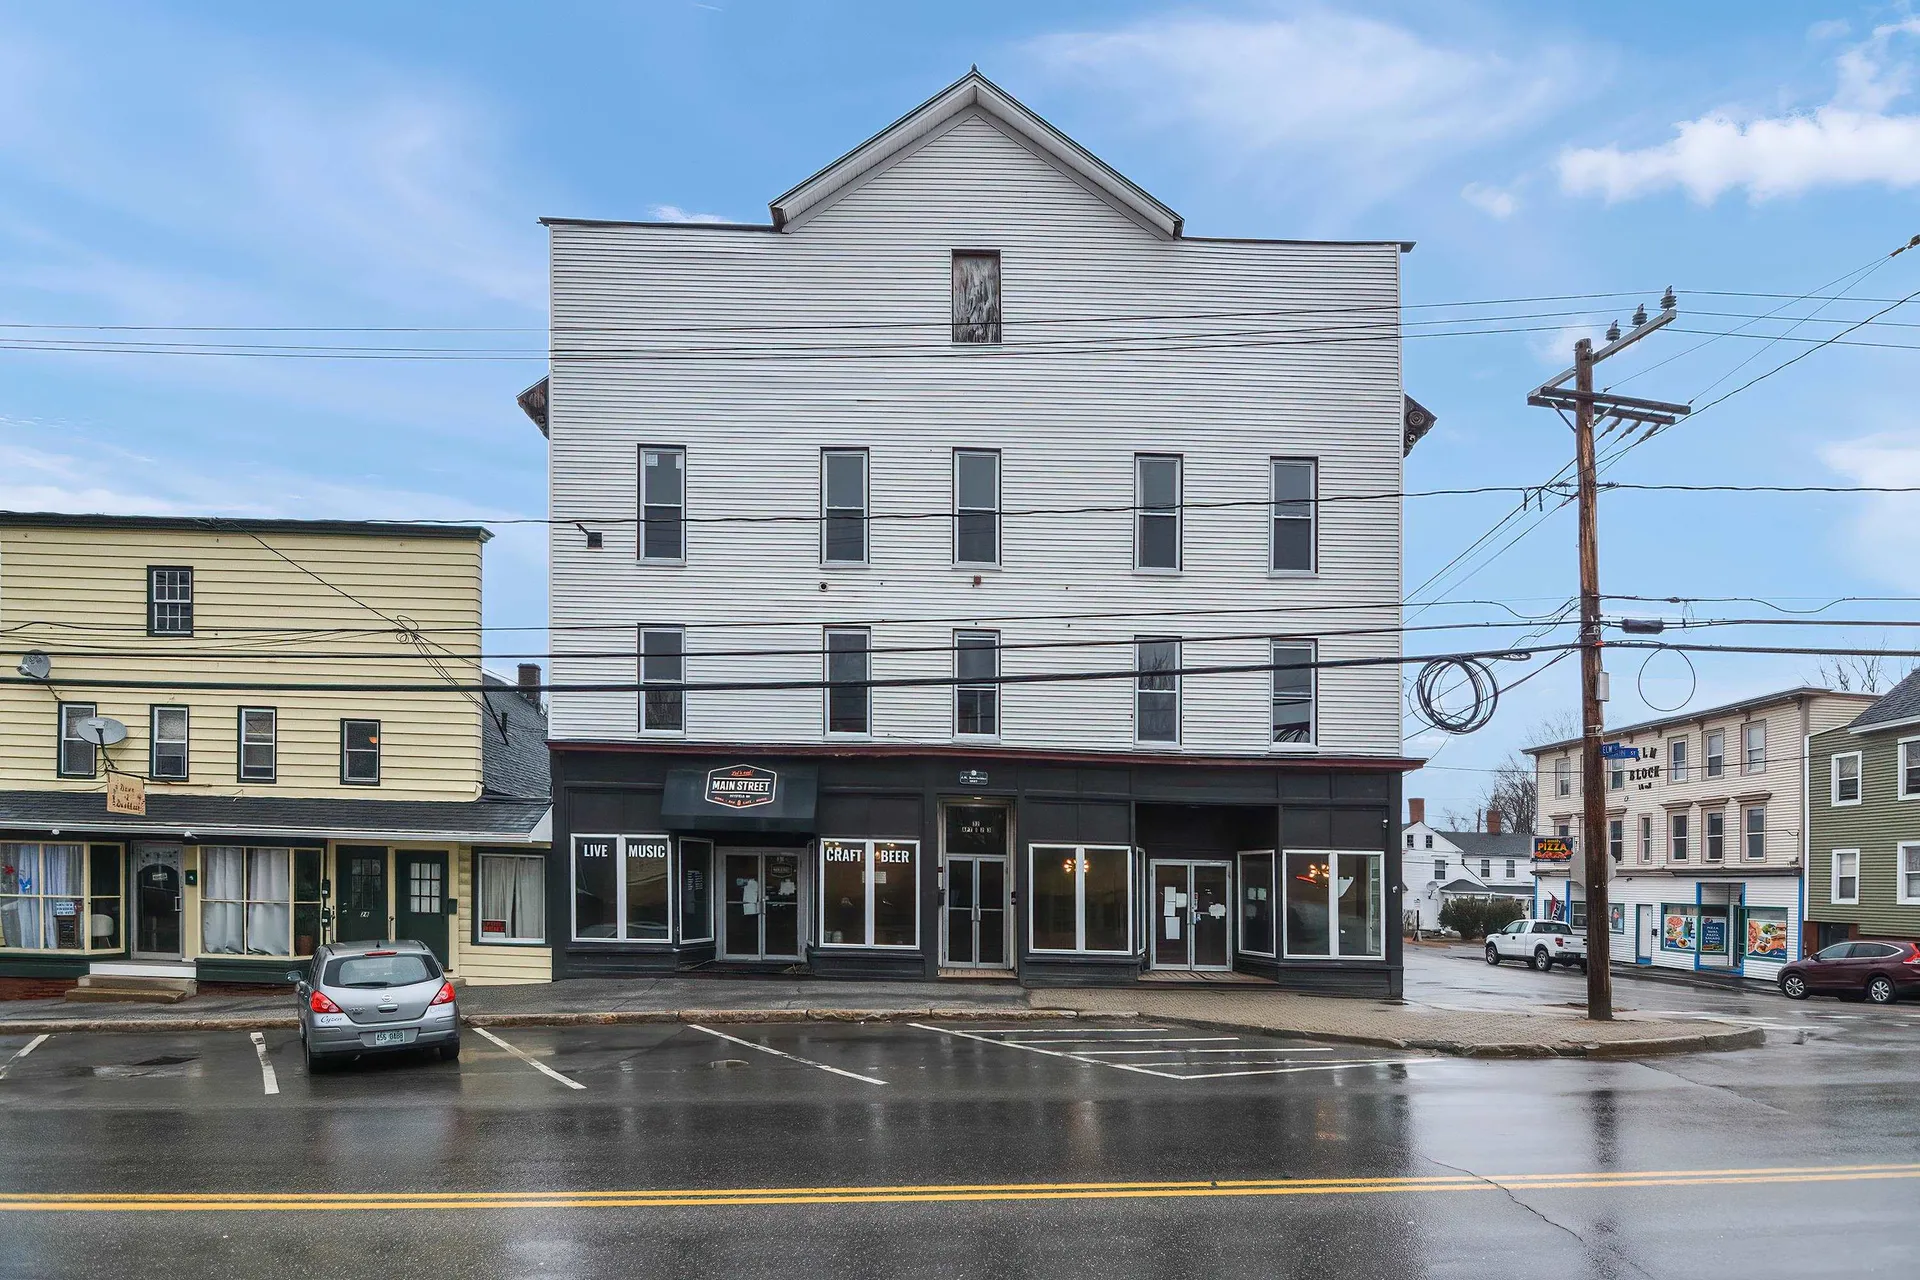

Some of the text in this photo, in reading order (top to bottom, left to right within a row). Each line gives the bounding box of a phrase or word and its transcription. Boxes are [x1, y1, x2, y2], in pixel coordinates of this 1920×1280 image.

[1602, 745, 1613, 754] ELM
[1629, 766, 1660, 780] BLOCK
[712, 780, 770, 792] MAIN STREET
[583, 844, 608, 862] LIVE
[1537, 842, 1568, 851] PIZZA
[628, 844, 666, 863] MUSIC
[826, 848, 863, 862] CRAFT
[880, 850, 910, 863] BEER
